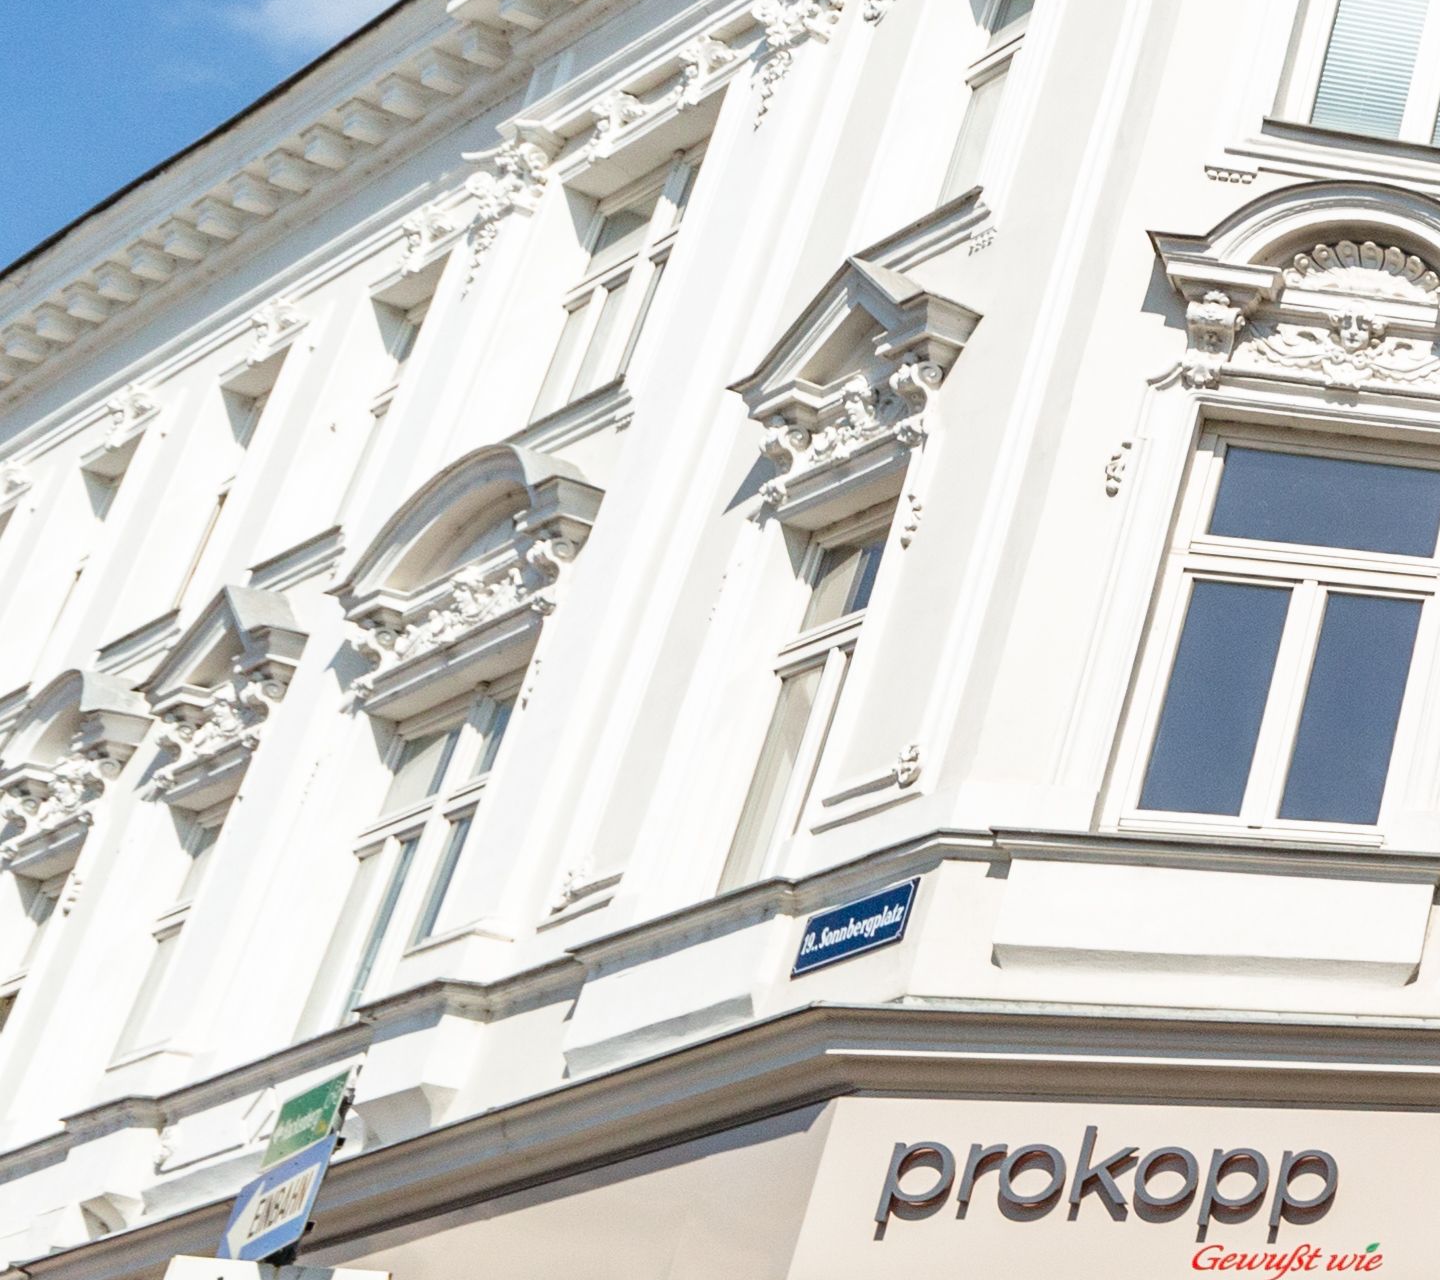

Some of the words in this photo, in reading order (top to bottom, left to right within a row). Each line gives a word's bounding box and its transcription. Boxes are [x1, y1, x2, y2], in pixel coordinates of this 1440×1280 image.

[819, 903, 905, 949] Sonnbergplatz
[247, 1167, 316, 1239] EINBAHN
[874, 1125, 1339, 1230] prokopp
[1326, 1243, 1384, 1272] wie
